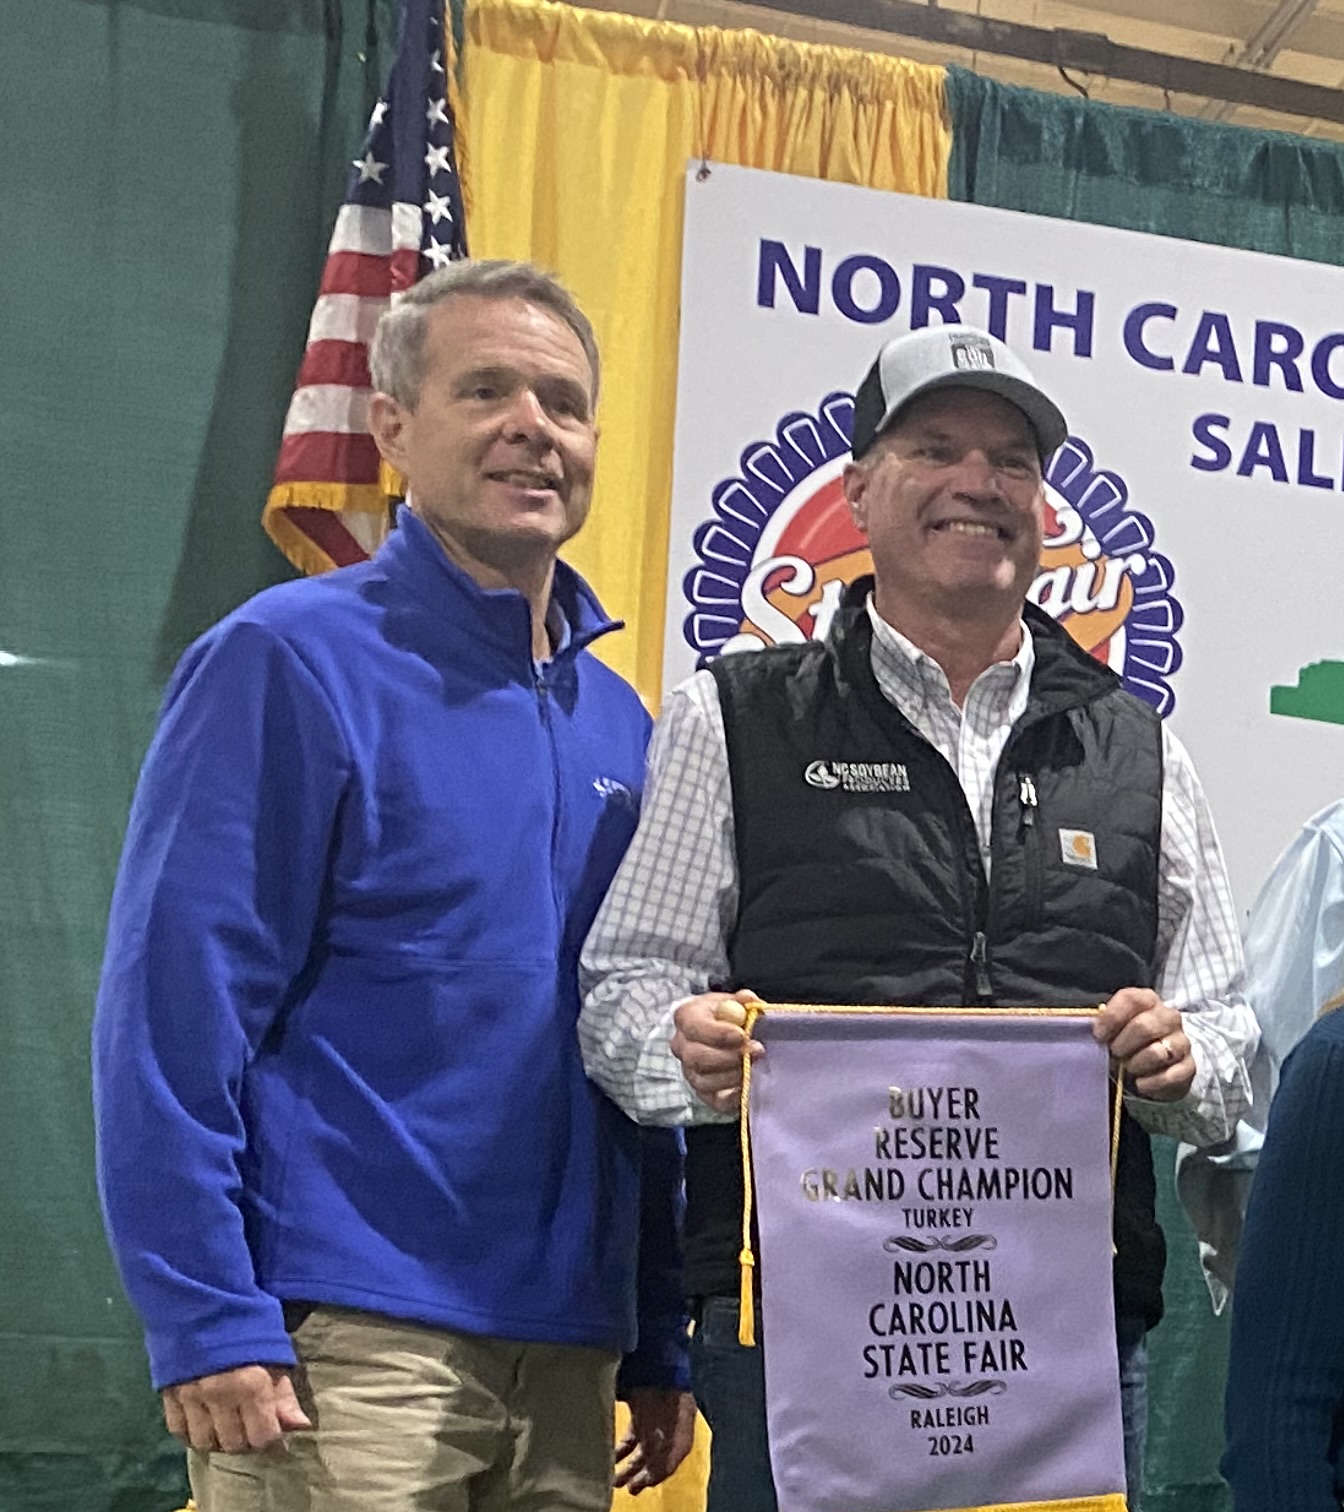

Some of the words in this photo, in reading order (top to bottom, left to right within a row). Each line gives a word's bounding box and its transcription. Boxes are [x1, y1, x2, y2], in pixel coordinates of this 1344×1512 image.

[757, 238, 1095, 358] NORTH
[888, 1086, 981, 1121] BUYER
[874, 1126, 1000, 1160] RESERVE
[802, 1169, 905, 1202] GRAND
[917, 1167, 1073, 1201] CHAMPION
[901, 1208, 975, 1229] TURKEY
[893, 1260, 991, 1295] NORTH
[869, 1298, 1018, 1337] CAROLINA
[862, 1344, 950, 1379] STATE
[963, 1338, 1028, 1374] FAIR
[910, 1406, 989, 1428] RALEIGH
[928, 1435, 975, 1456] 2024
